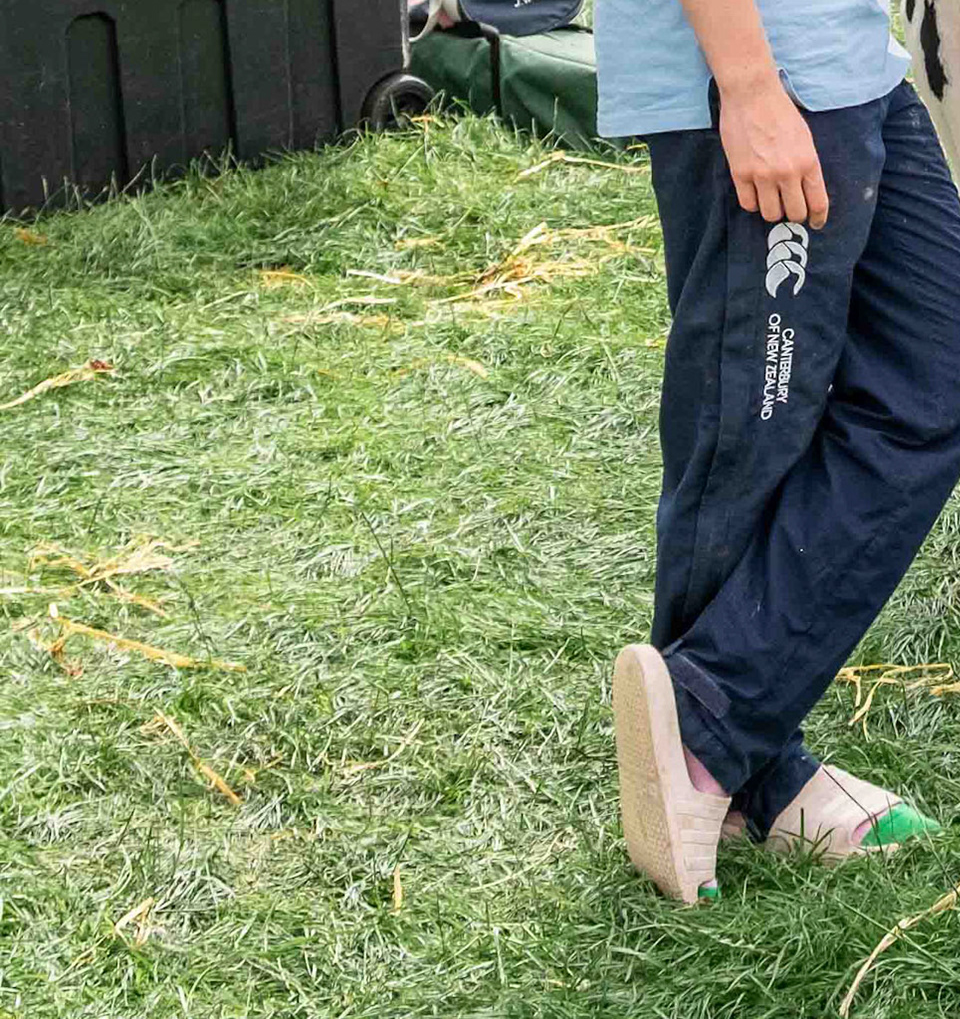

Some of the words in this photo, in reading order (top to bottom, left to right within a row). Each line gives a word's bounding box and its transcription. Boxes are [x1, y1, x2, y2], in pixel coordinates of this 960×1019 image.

[768, 313, 782, 334] OF
[766, 334, 779, 363] NEW
[776, 328, 795, 403] CANTERBURY
[760, 364, 777, 420] ZEALAND
